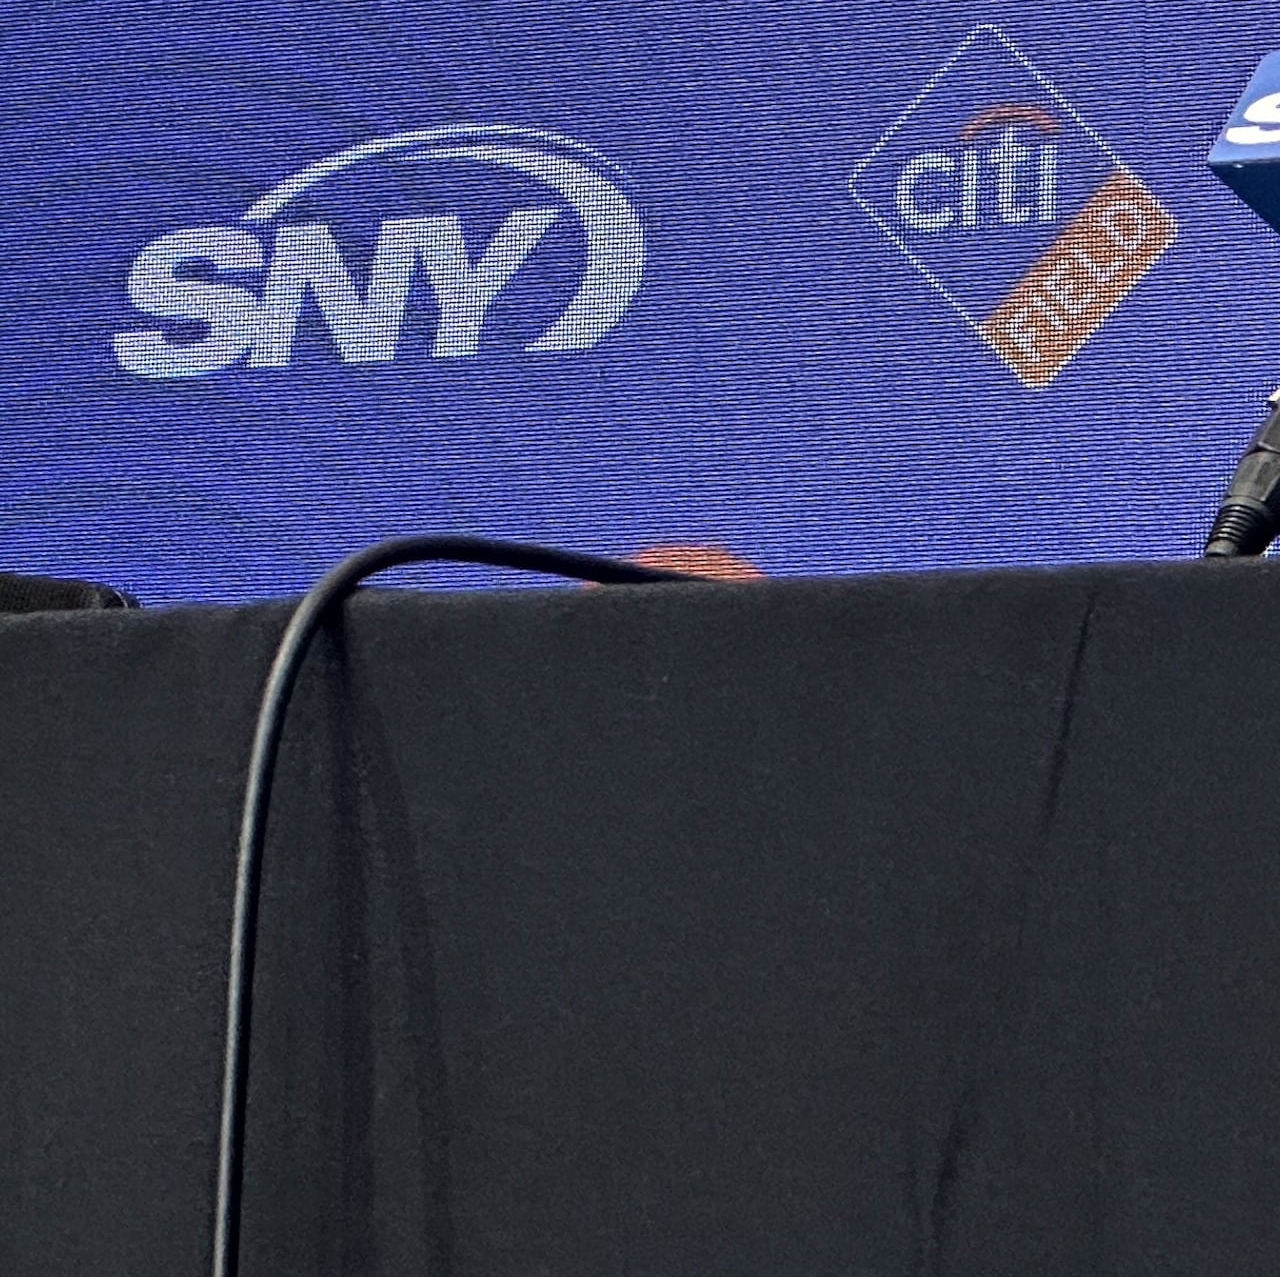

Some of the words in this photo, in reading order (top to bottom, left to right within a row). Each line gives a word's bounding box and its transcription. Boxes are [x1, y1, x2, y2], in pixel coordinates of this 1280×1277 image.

[895, 122, 1058, 231] citi
[113, 204, 566, 380] SNY
[1002, 199, 1148, 364] FIELD
